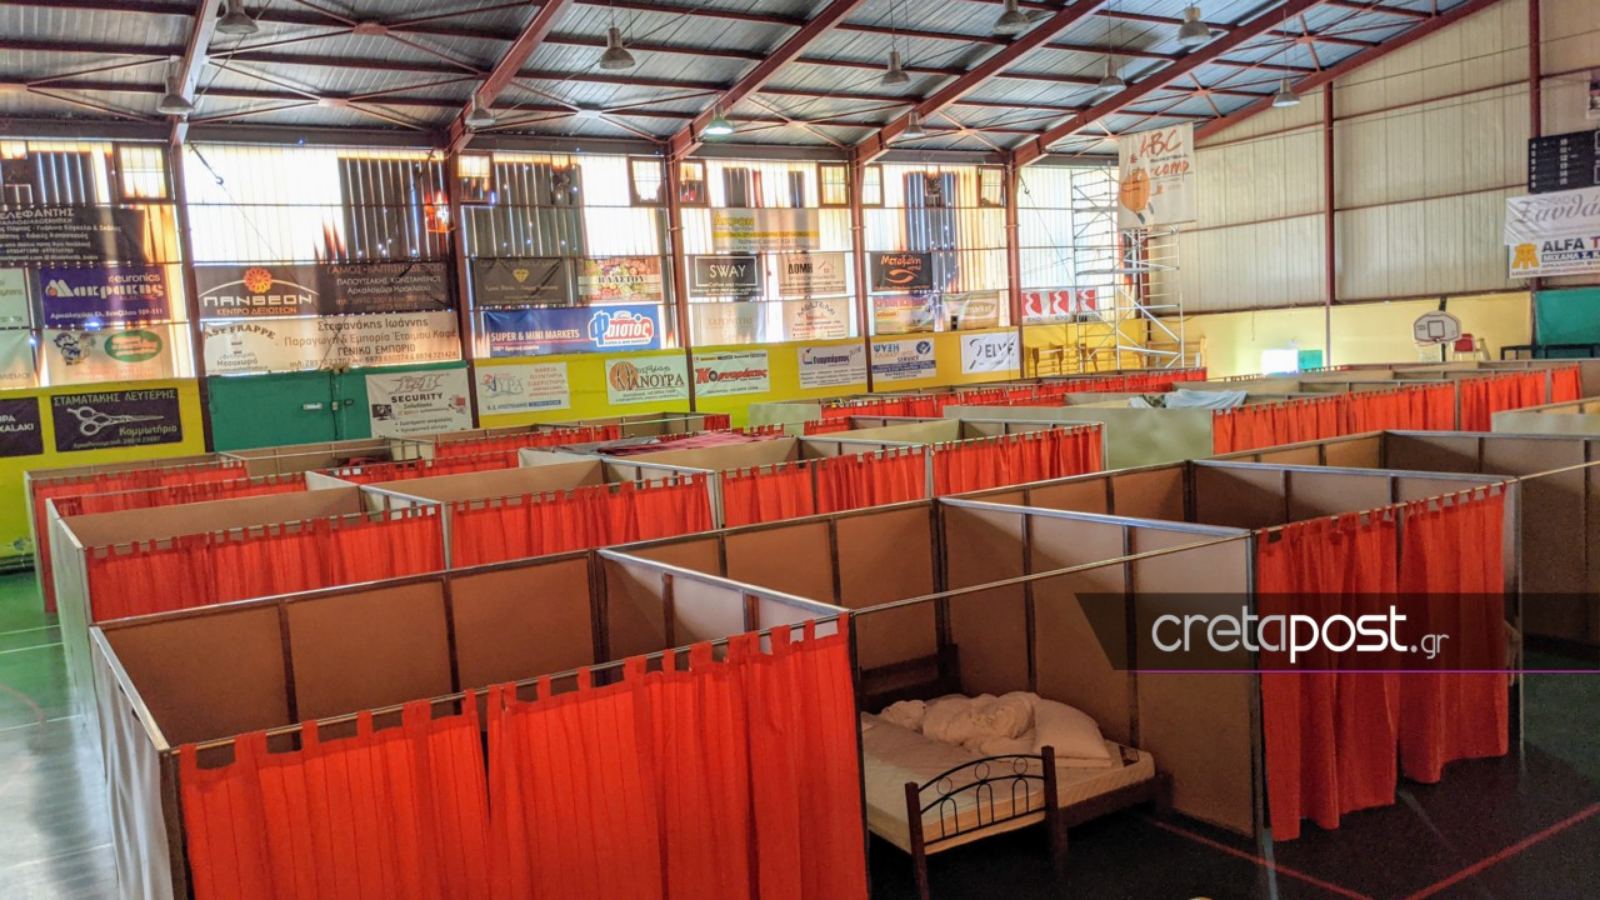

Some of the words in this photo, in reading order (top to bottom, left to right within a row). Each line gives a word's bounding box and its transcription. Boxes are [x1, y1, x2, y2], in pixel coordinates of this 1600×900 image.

[1542, 238, 1584, 253] ALFA
[709, 264, 746, 278] SWAY
[317, 320, 382, 331] Στεφανάκης
[385, 318, 429, 328] Ιωάννης
[230, 324, 276, 340] FRAPPE
[350, 331, 390, 344] Εμπορία
[491, 331, 516, 342] SUPER
[518, 332, 524, 341] &
[545, 329, 580, 340] MARKETS
[337, 345, 371, 356] ΓΕΝΙΚΟ
[375, 344, 416, 355] ΕΜΠΟΡΙΟ
[873, 343, 899, 353] ΨΥΞΗ
[54, 396, 121, 406] ΣΤΑΜΑΤΑΚΗΣ
[125, 390, 176, 401] ΛΕΥΤΕΡΗΣ
[391, 392, 443, 403] SECURITY
